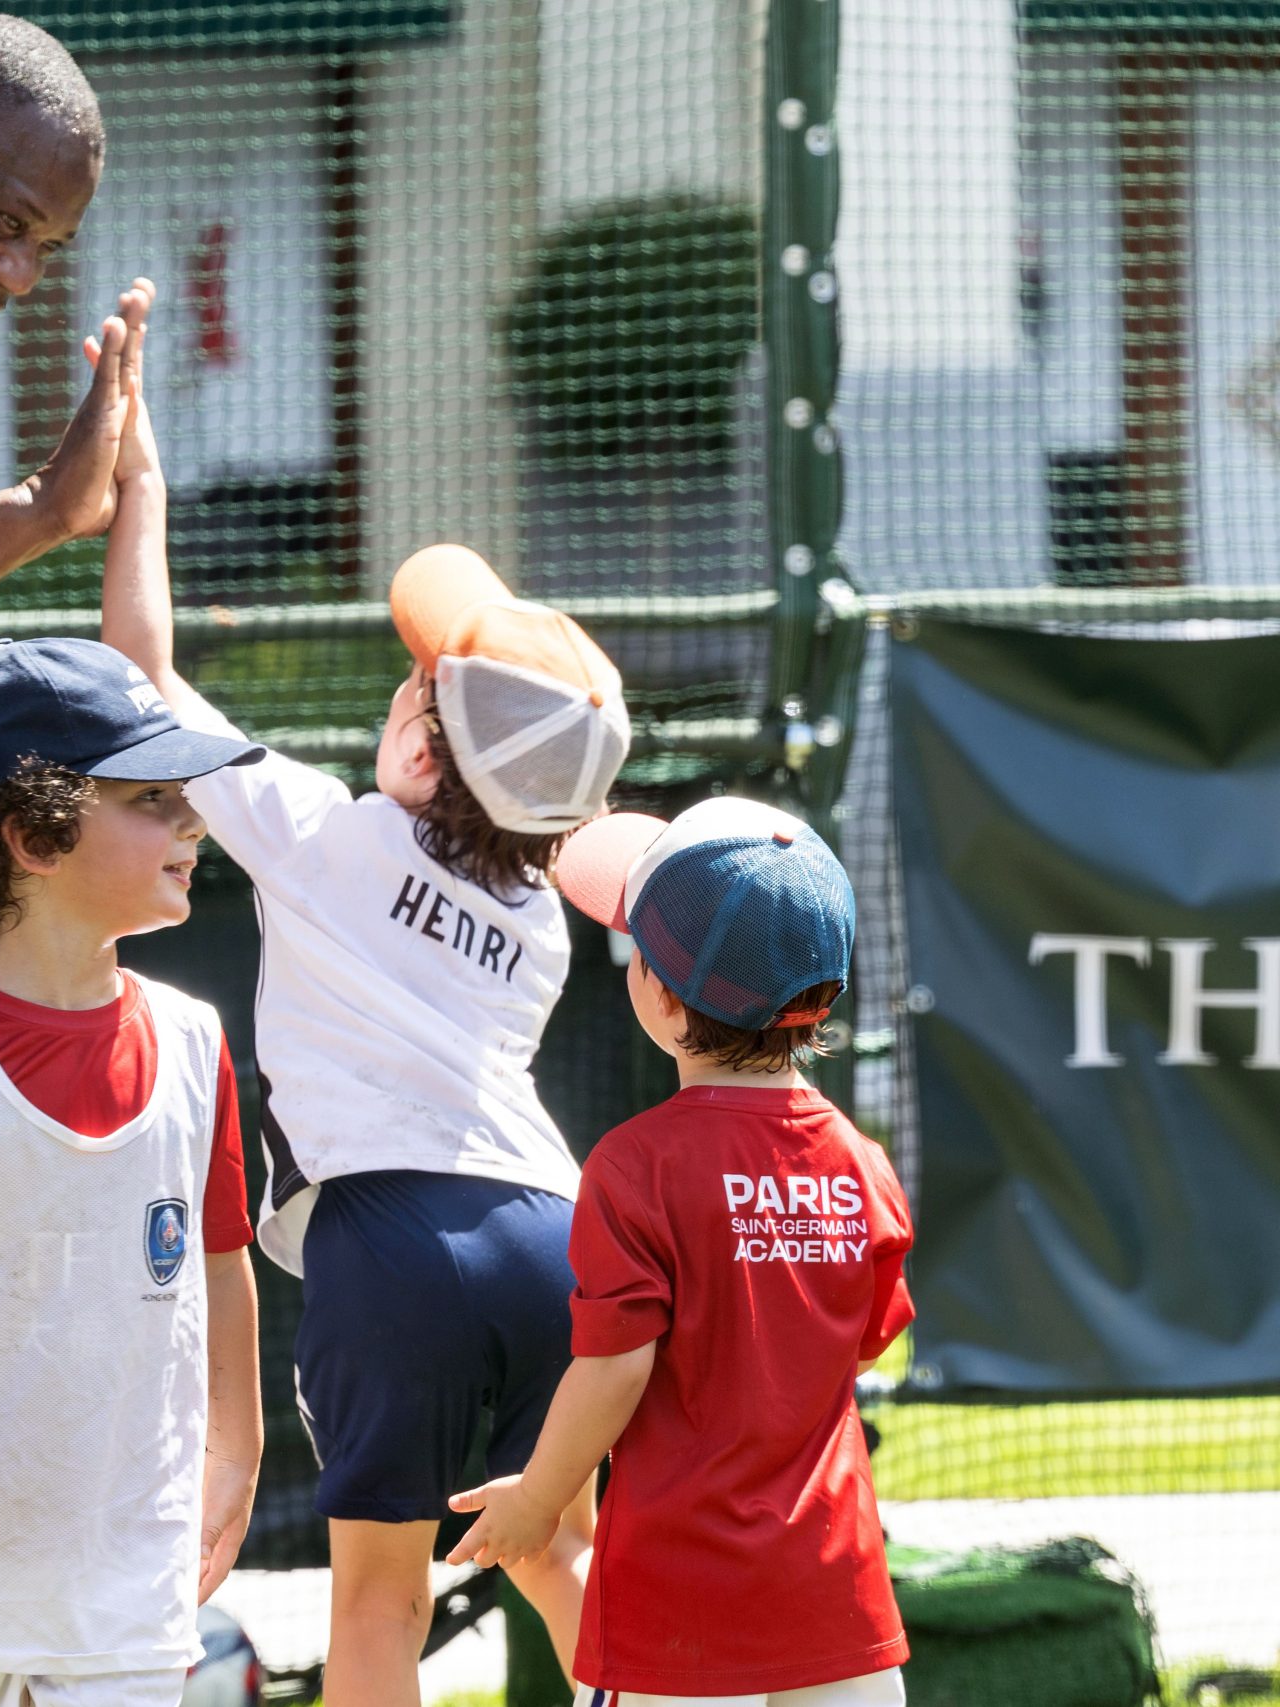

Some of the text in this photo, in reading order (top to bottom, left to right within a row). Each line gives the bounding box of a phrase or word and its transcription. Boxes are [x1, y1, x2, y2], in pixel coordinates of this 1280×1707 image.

[1028, 932, 1280, 1069] TH
[722, 1174, 862, 1215] PARIS
[731, 1218, 868, 1235] SAINT-GERMAIN
[734, 1239, 868, 1263] ACADEMY
